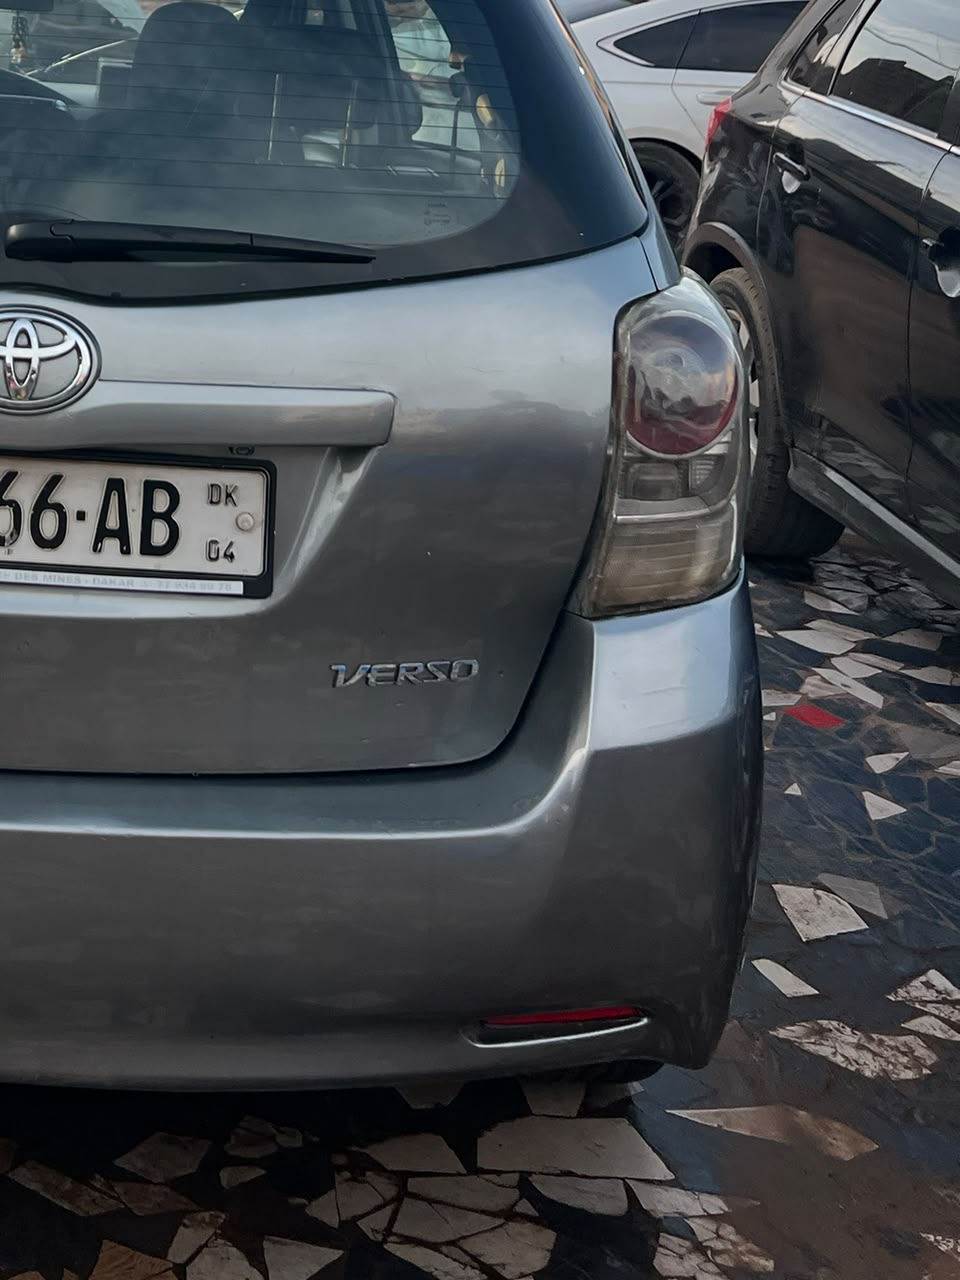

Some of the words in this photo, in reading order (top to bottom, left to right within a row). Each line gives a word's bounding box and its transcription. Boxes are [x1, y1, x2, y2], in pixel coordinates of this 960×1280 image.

[208, 482, 239, 507] DK
[206, 539, 236, 563] 04
[15, 572, 38, 582] DES
[331, 659, 480, 688] VERSO
